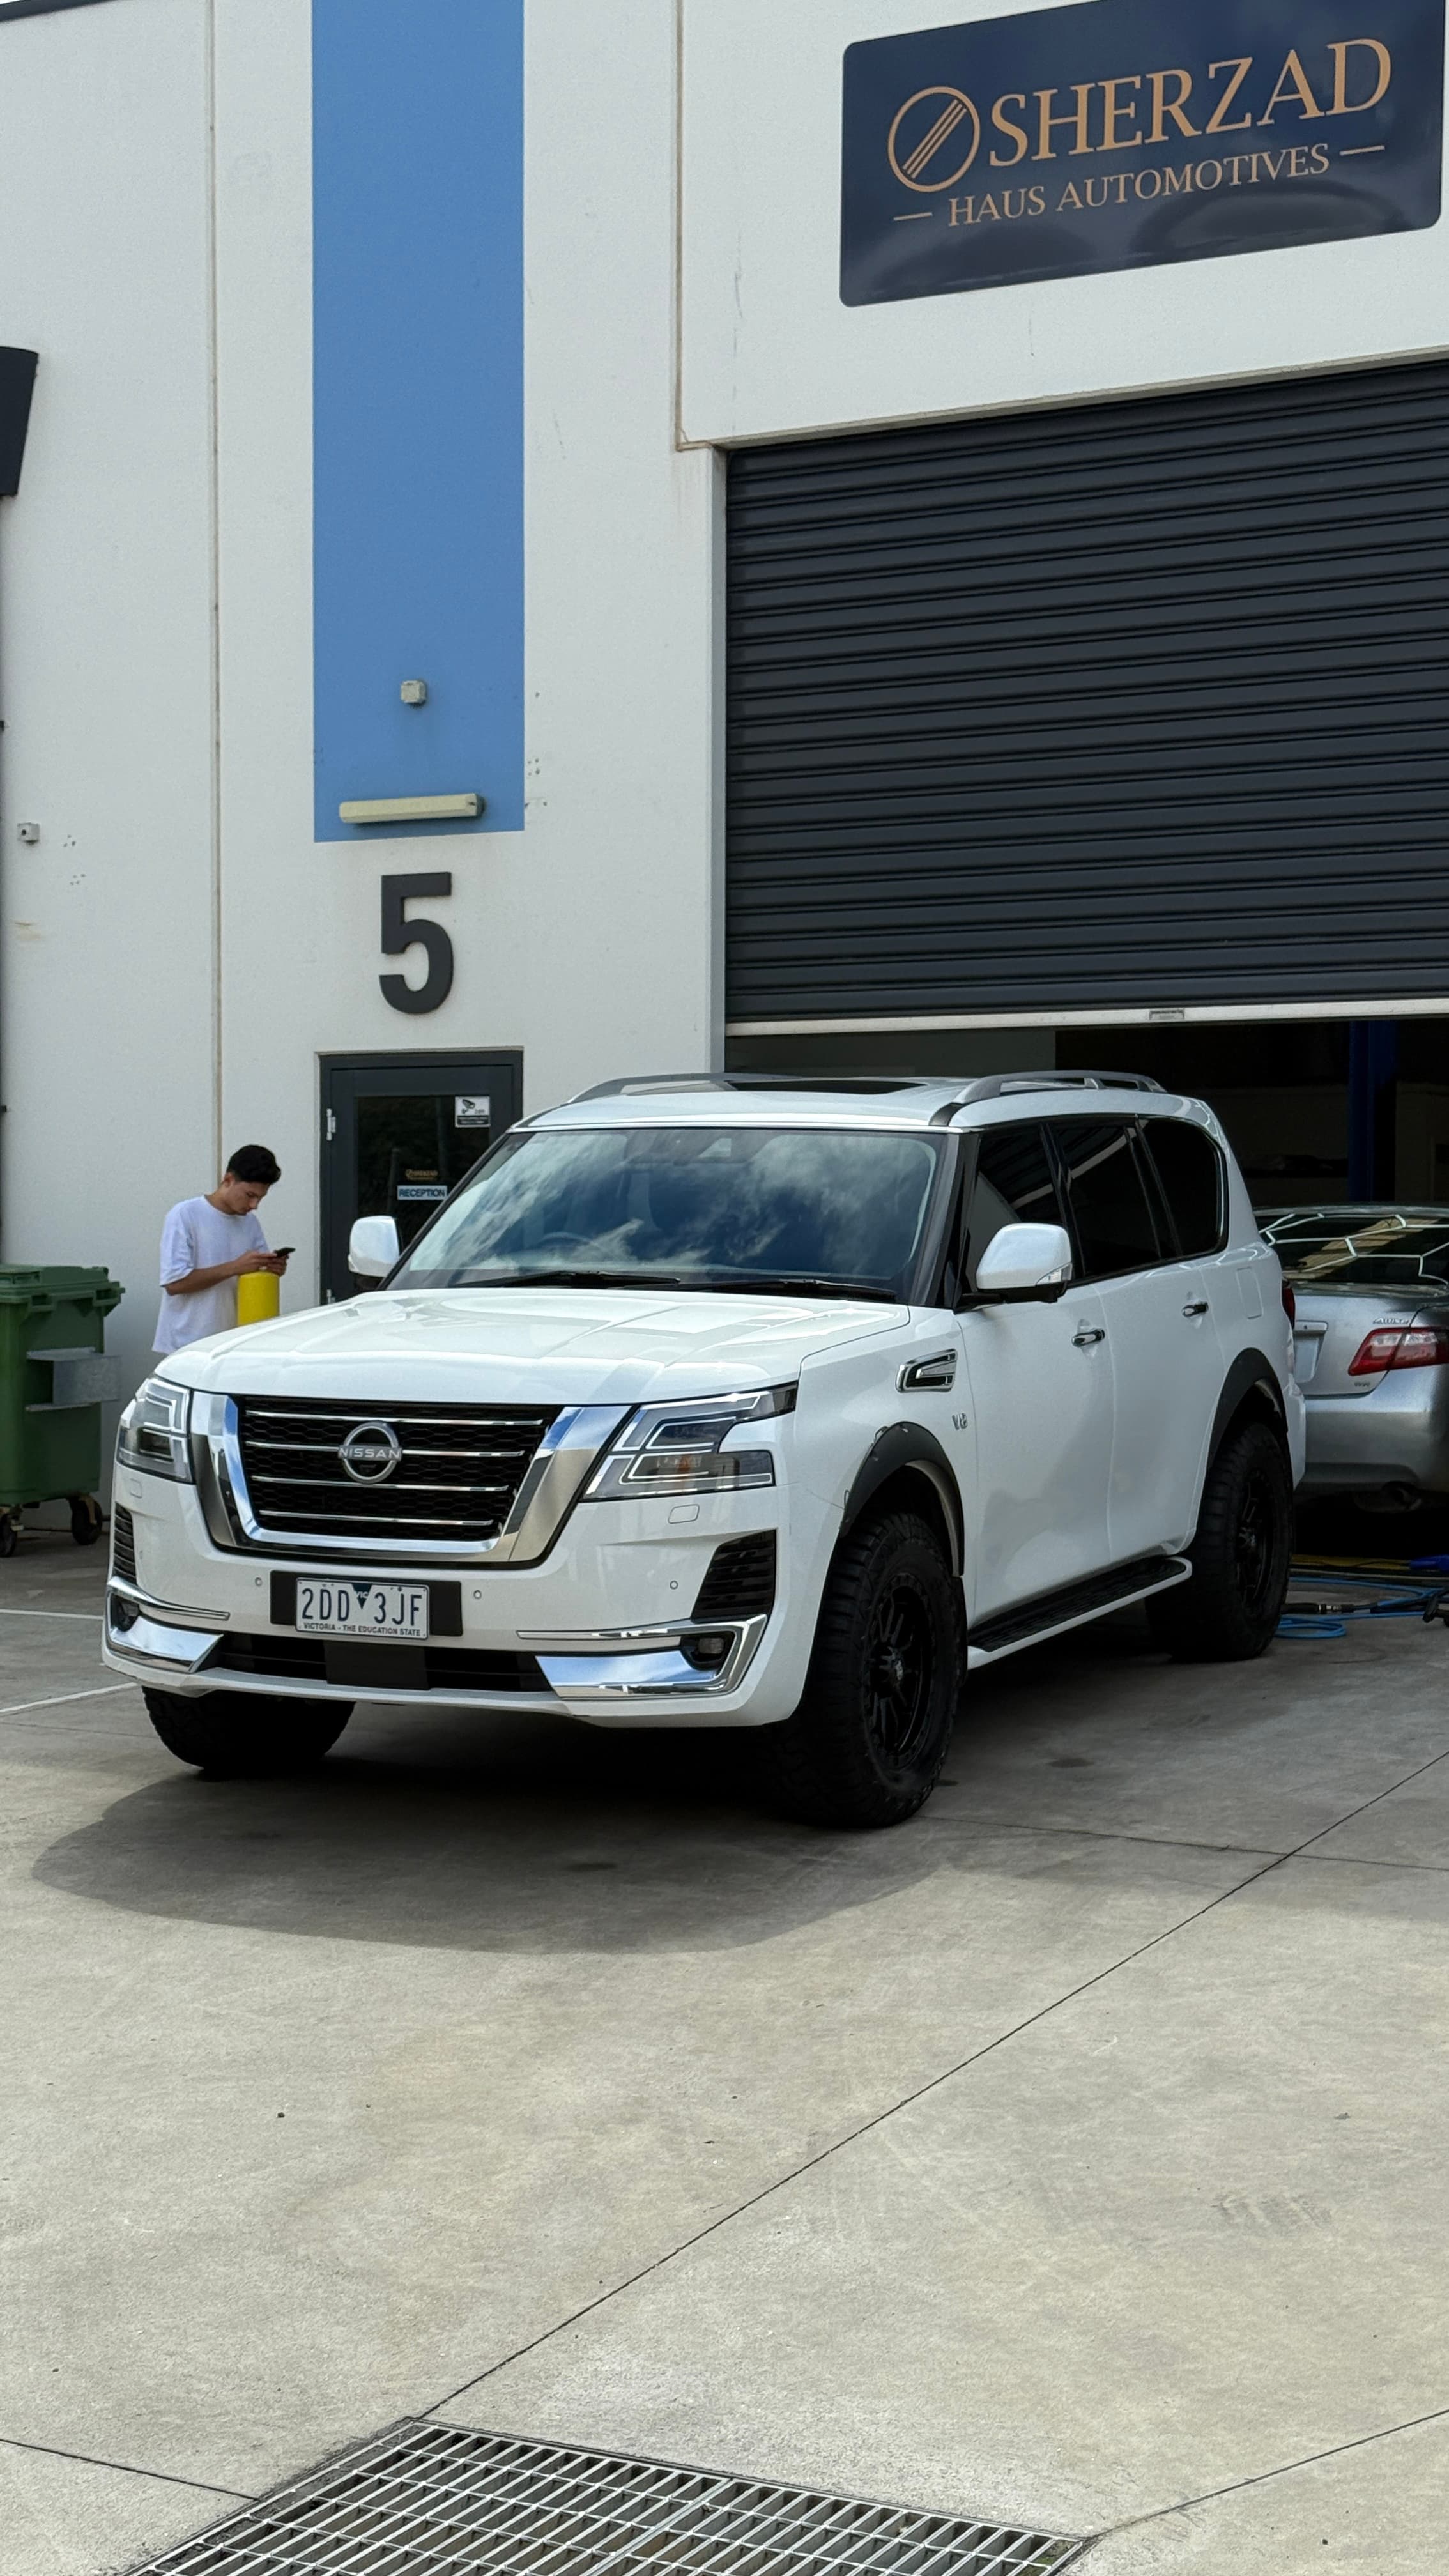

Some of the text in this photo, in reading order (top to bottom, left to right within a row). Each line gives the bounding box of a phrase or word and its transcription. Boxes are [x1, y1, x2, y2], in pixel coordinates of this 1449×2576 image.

[989, 38, 1392, 167] SHERZAD
[949, 142, 1330, 227] HAUS AUTOMOTIVES
[379, 871, 454, 1015] 5
[951, 1412, 968, 1430] V8
[340, 1447, 401, 1459] NISSAN
[374, 1592, 422, 1626] 3JF
[303, 1622, 335, 1631] VICTORIA
[343, 1624, 356, 1632] THE
[358, 1625, 397, 1635] EDUCATION
[400, 1628, 420, 1636] STATE
